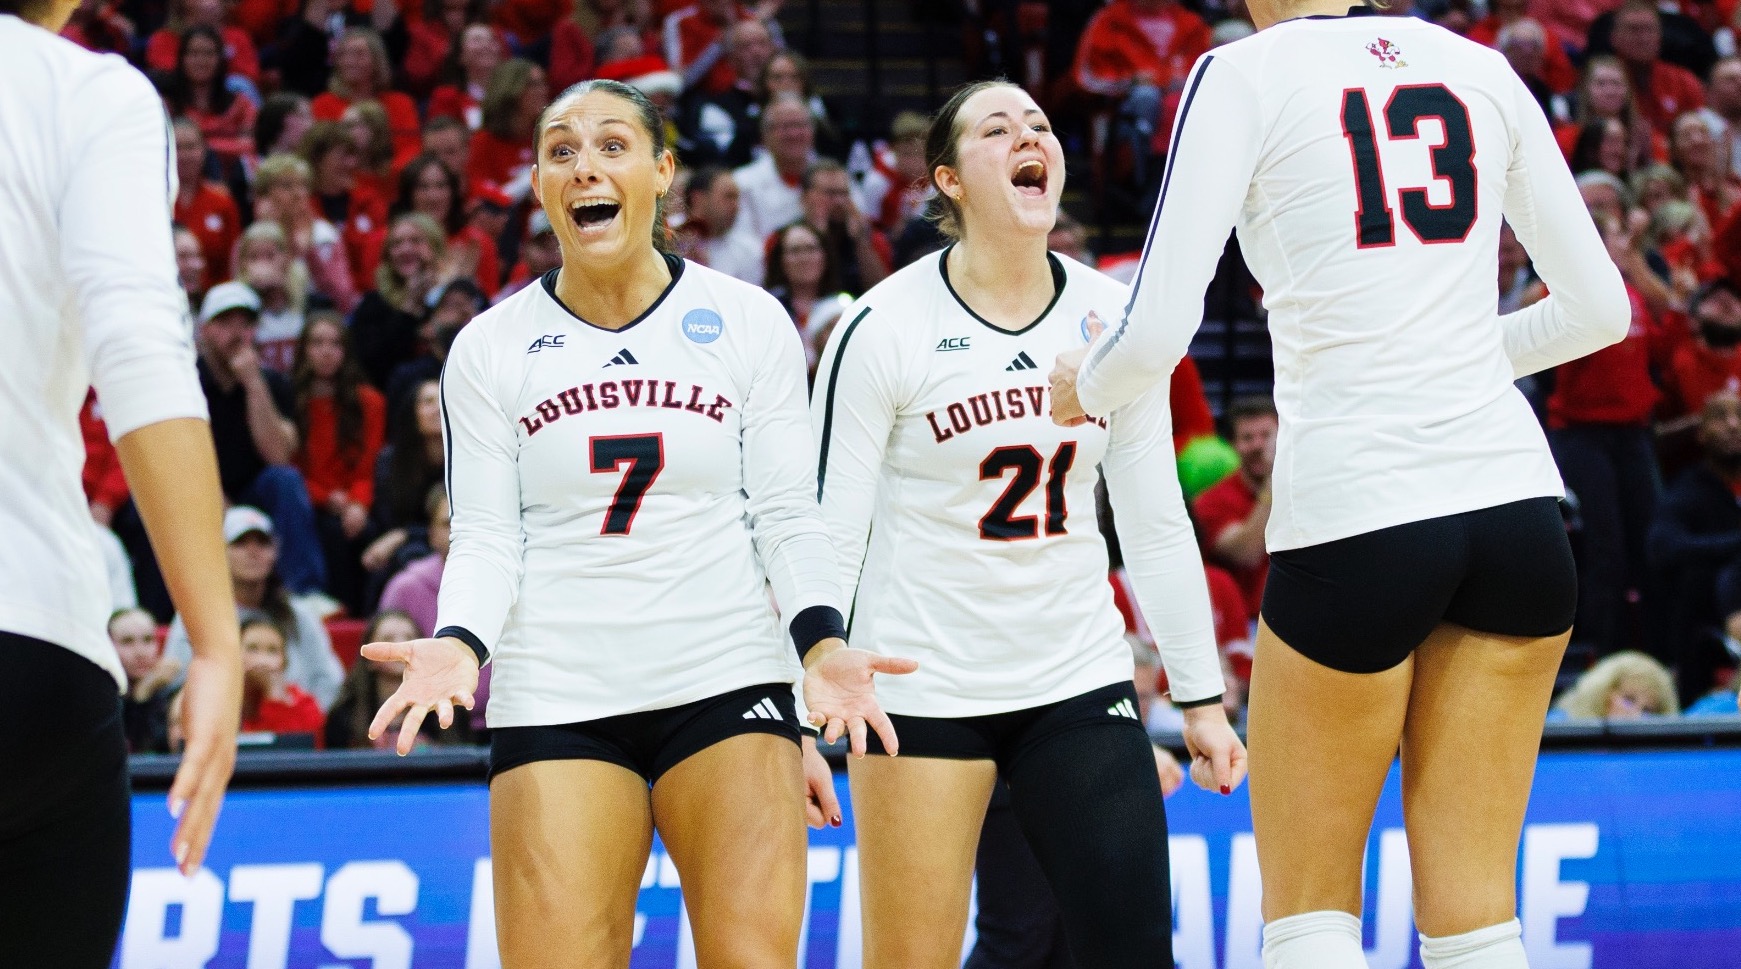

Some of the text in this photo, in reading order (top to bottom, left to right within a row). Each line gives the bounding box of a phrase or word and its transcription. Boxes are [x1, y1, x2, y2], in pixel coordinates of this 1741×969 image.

[1340, 83, 1478, 249] 13
[528, 334, 567, 351] ACC
[687, 323, 720, 335] NCAA
[935, 336, 971, 350] ACC
[519, 379, 733, 437] LOUISVILLE
[925, 386, 1107, 444] LOUISV
[588, 431, 665, 535] 7
[978, 440, 1077, 542] 21
[113, 859, 419, 969] RTS
